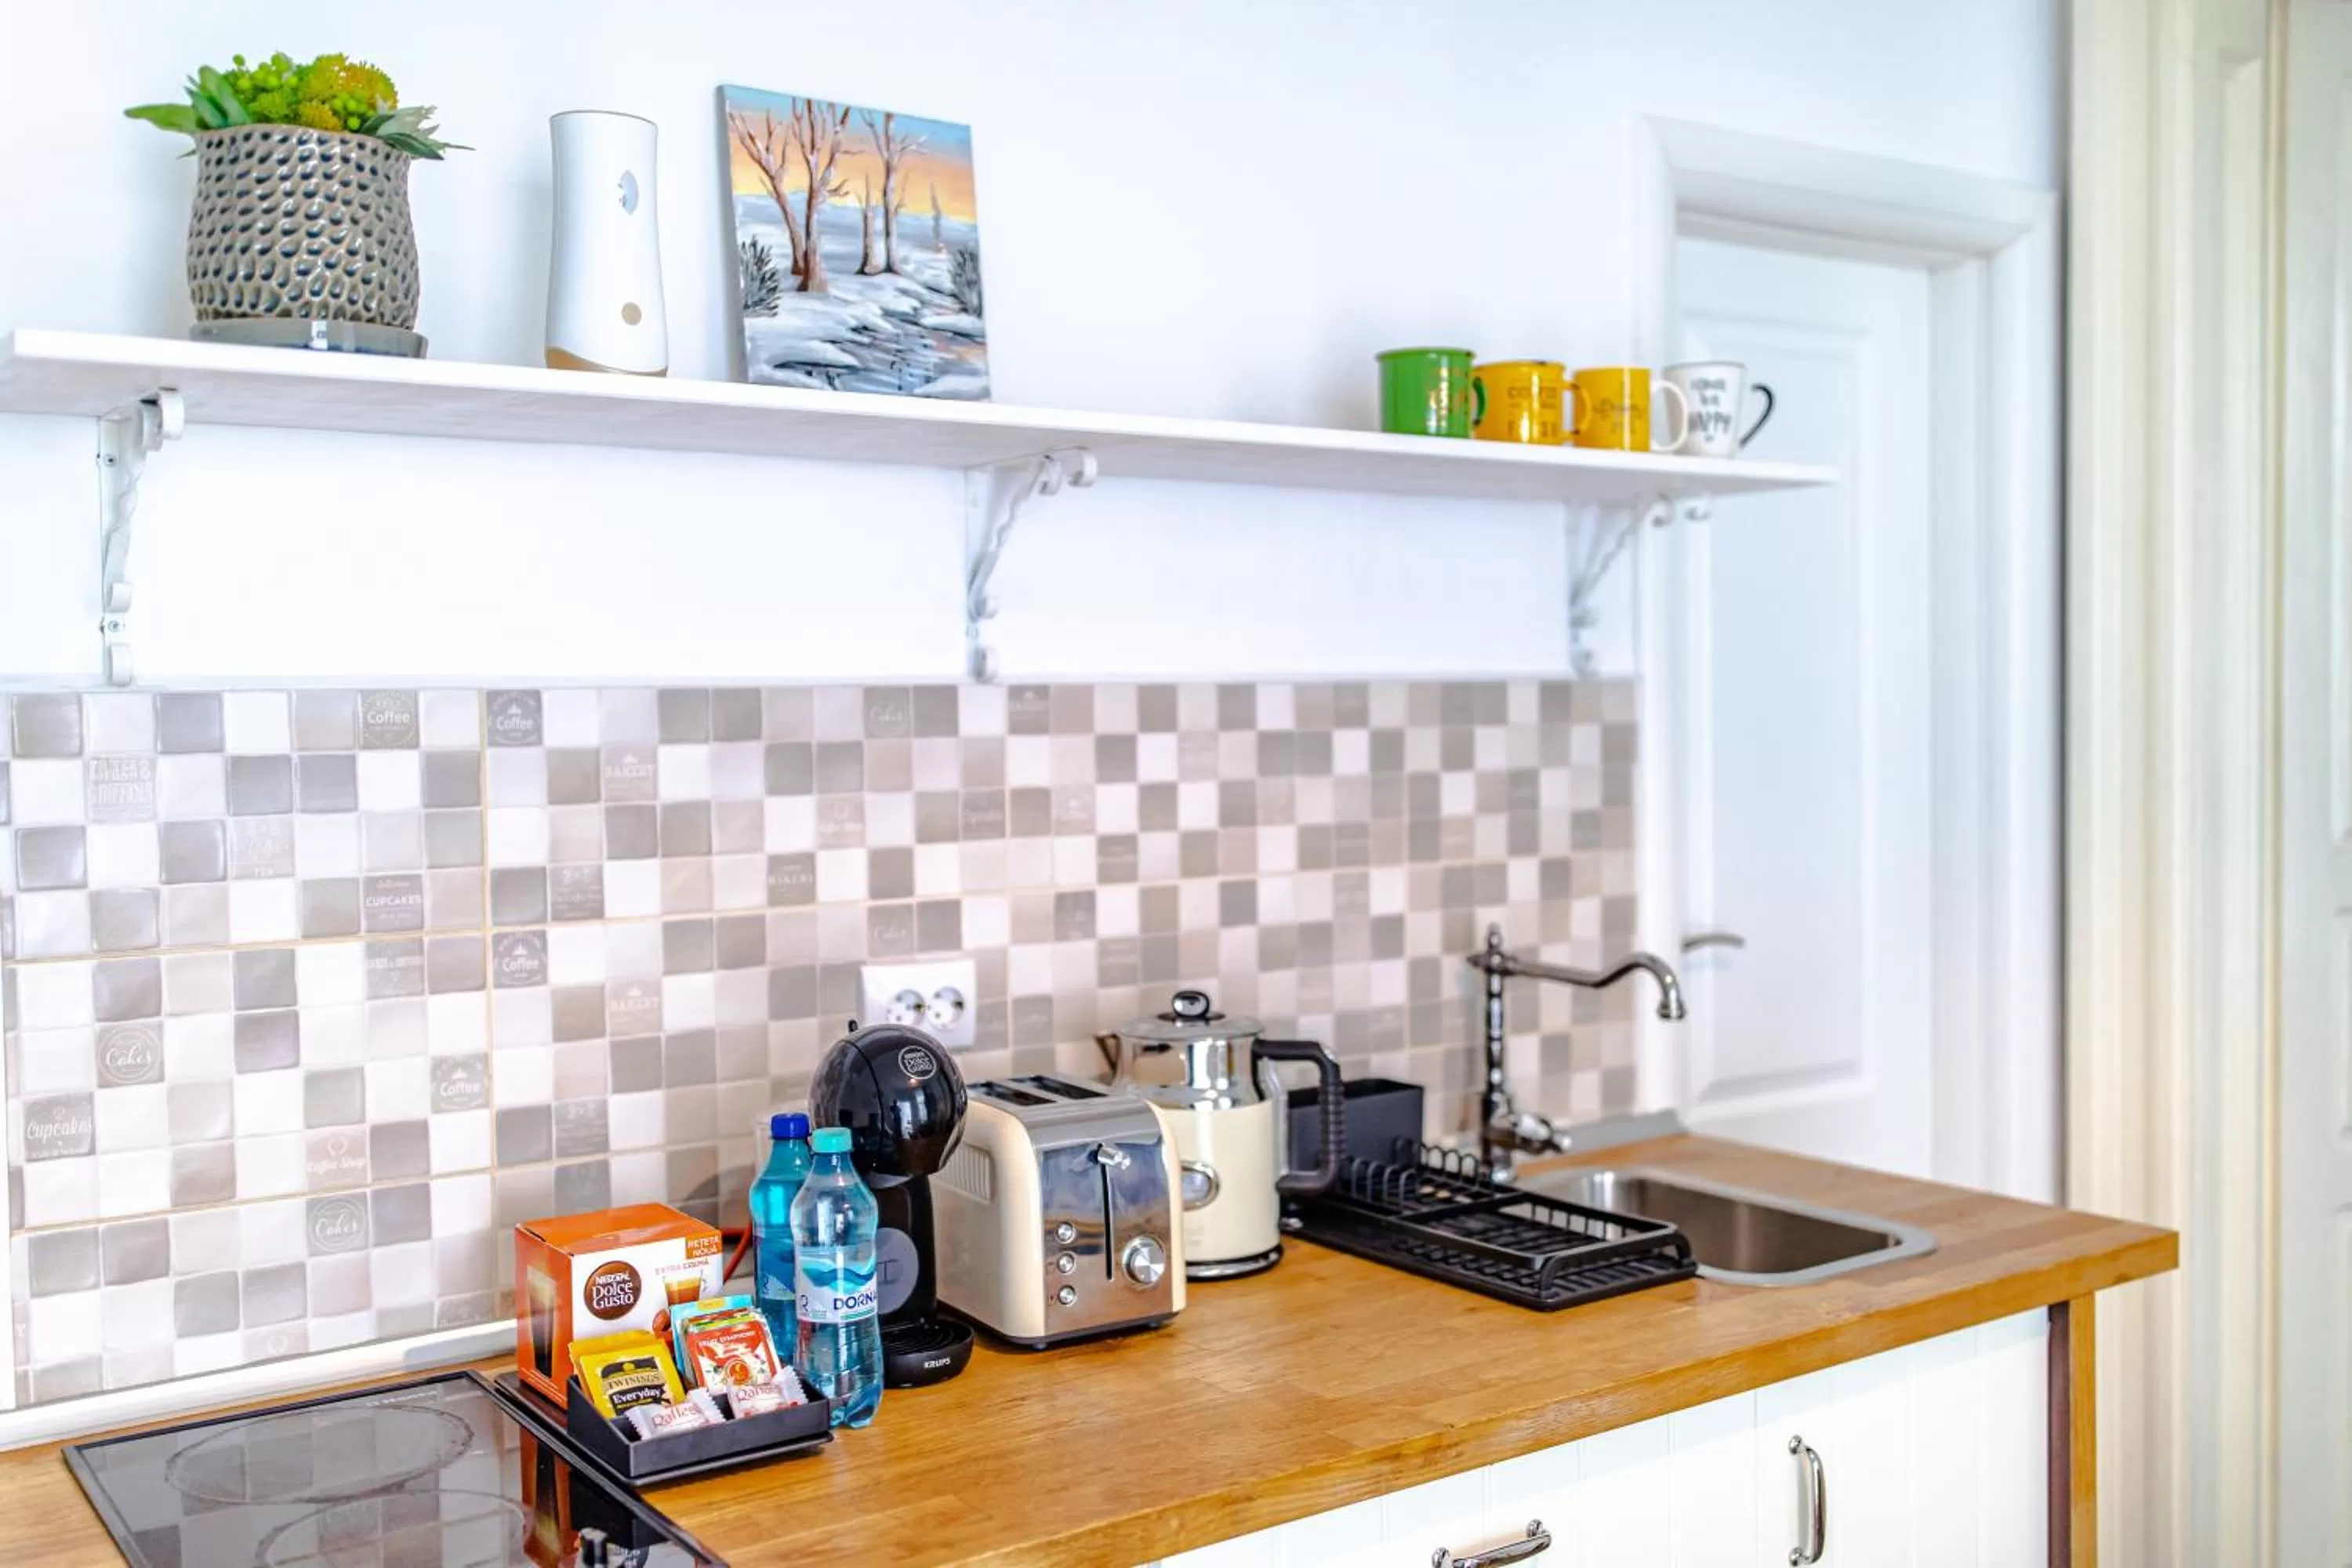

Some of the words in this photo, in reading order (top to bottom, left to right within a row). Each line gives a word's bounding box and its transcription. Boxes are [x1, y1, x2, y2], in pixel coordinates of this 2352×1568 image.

[367, 710, 410, 724] Coffee
[495, 715, 534, 731] Coffee
[365, 893, 422, 908] CUPCAKES
[502, 956, 540, 973] Coffee
[106, 1041, 152, 1067] Cakes
[439, 1080, 481, 1097] Coffee
[26, 1115, 92, 1145] Cupcakes
[315, 1213, 358, 1237] Cakes
[593, 1281, 633, 1300] Dolce
[593, 1293, 634, 1309] Gusto
[924, 1356, 952, 1369] KRUPS
[608, 1374, 660, 1390] TWININGS
[612, 1387, 661, 1404] Everyday
